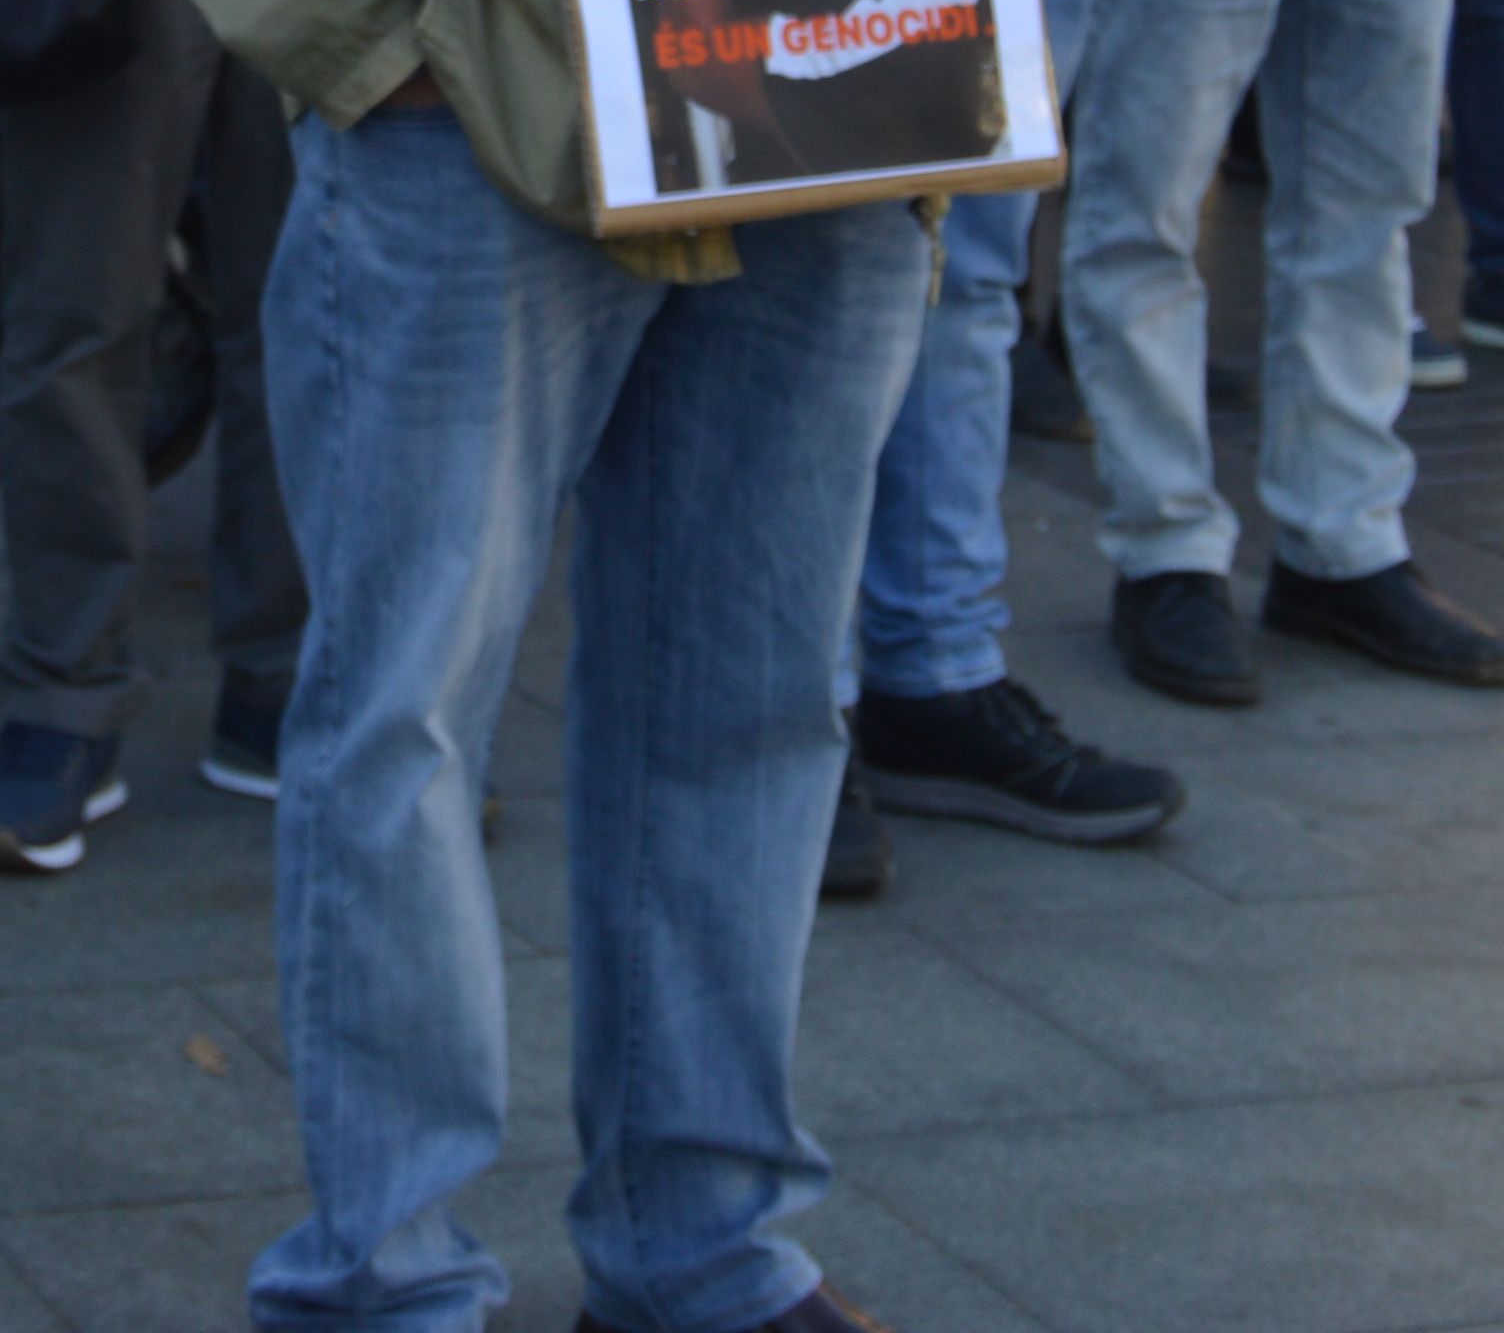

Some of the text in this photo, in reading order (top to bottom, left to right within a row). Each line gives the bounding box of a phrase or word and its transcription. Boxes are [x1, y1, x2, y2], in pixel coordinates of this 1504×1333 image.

[653, 19, 709, 70] ÉS
[711, 20, 773, 64] UN
[781, 2, 979, 56] GENOCIDI
